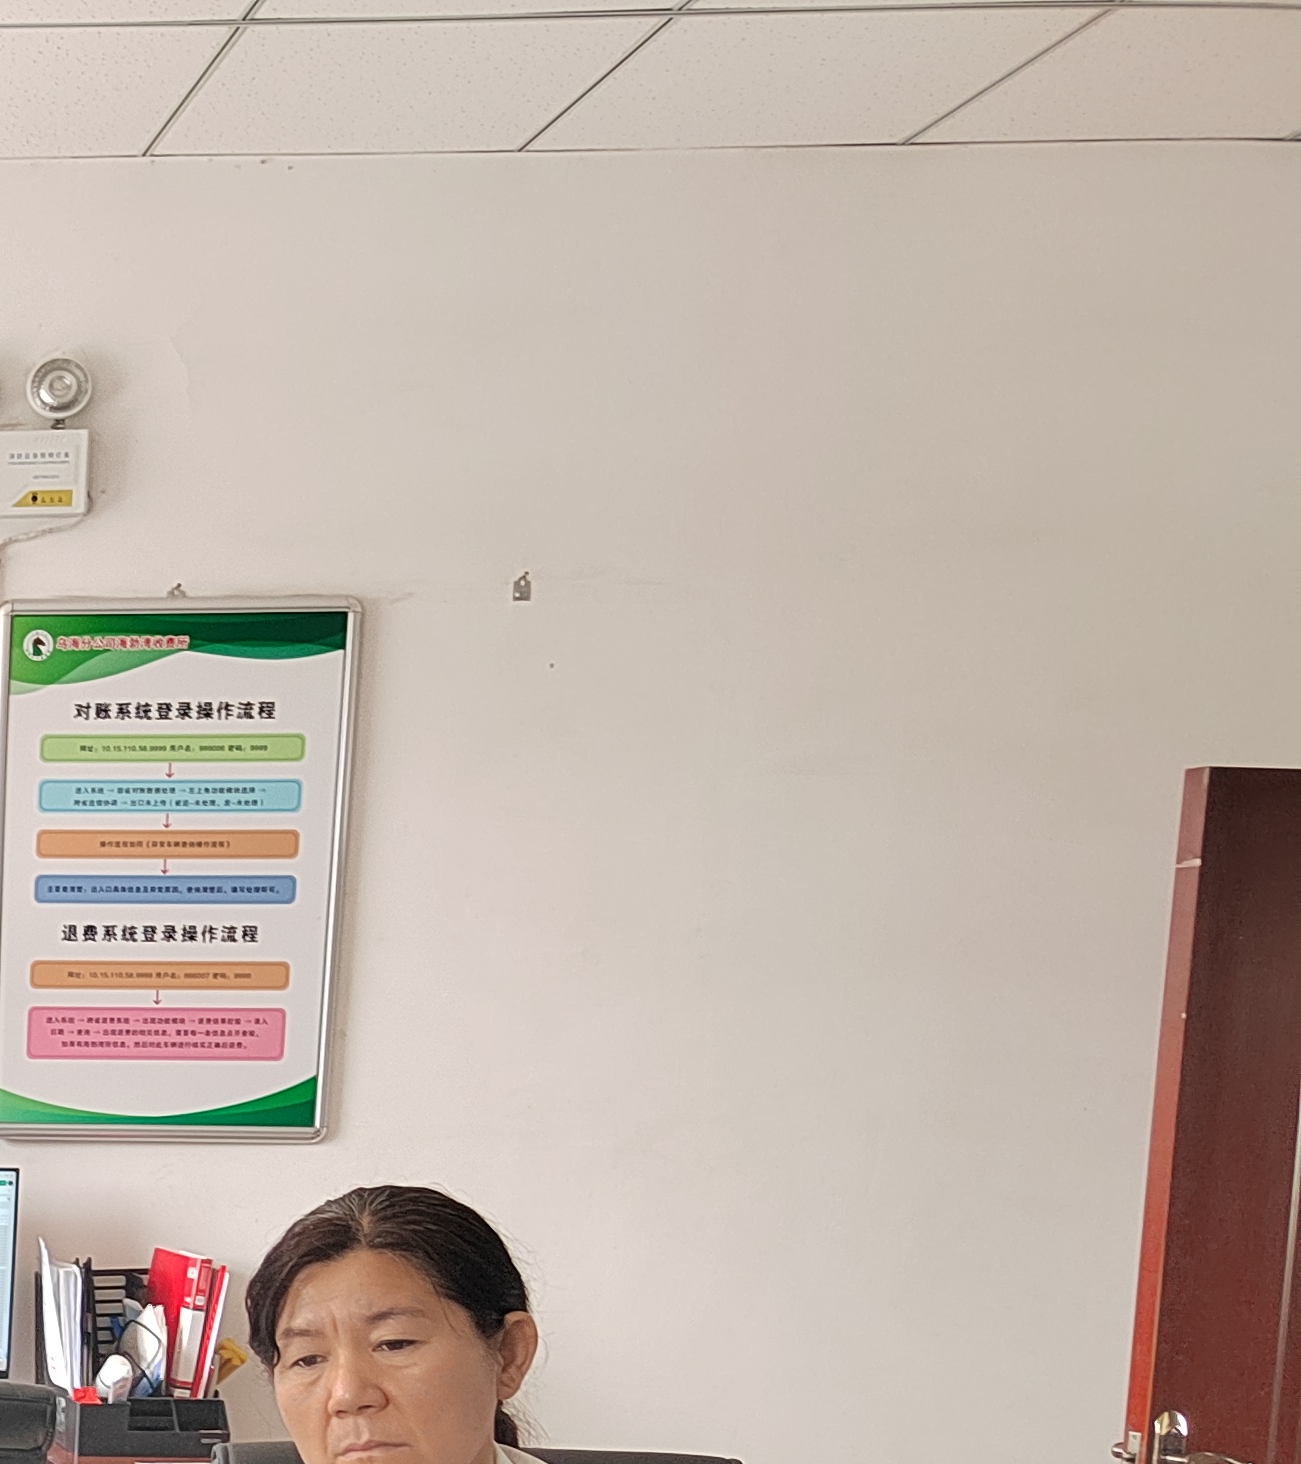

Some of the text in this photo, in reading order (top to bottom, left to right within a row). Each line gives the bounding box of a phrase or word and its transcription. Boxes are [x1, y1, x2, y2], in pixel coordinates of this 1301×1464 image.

[74, 701, 276, 721] 对账系统登录操作流程
[61, 924, 259, 943] 退费系统登录操作流程
